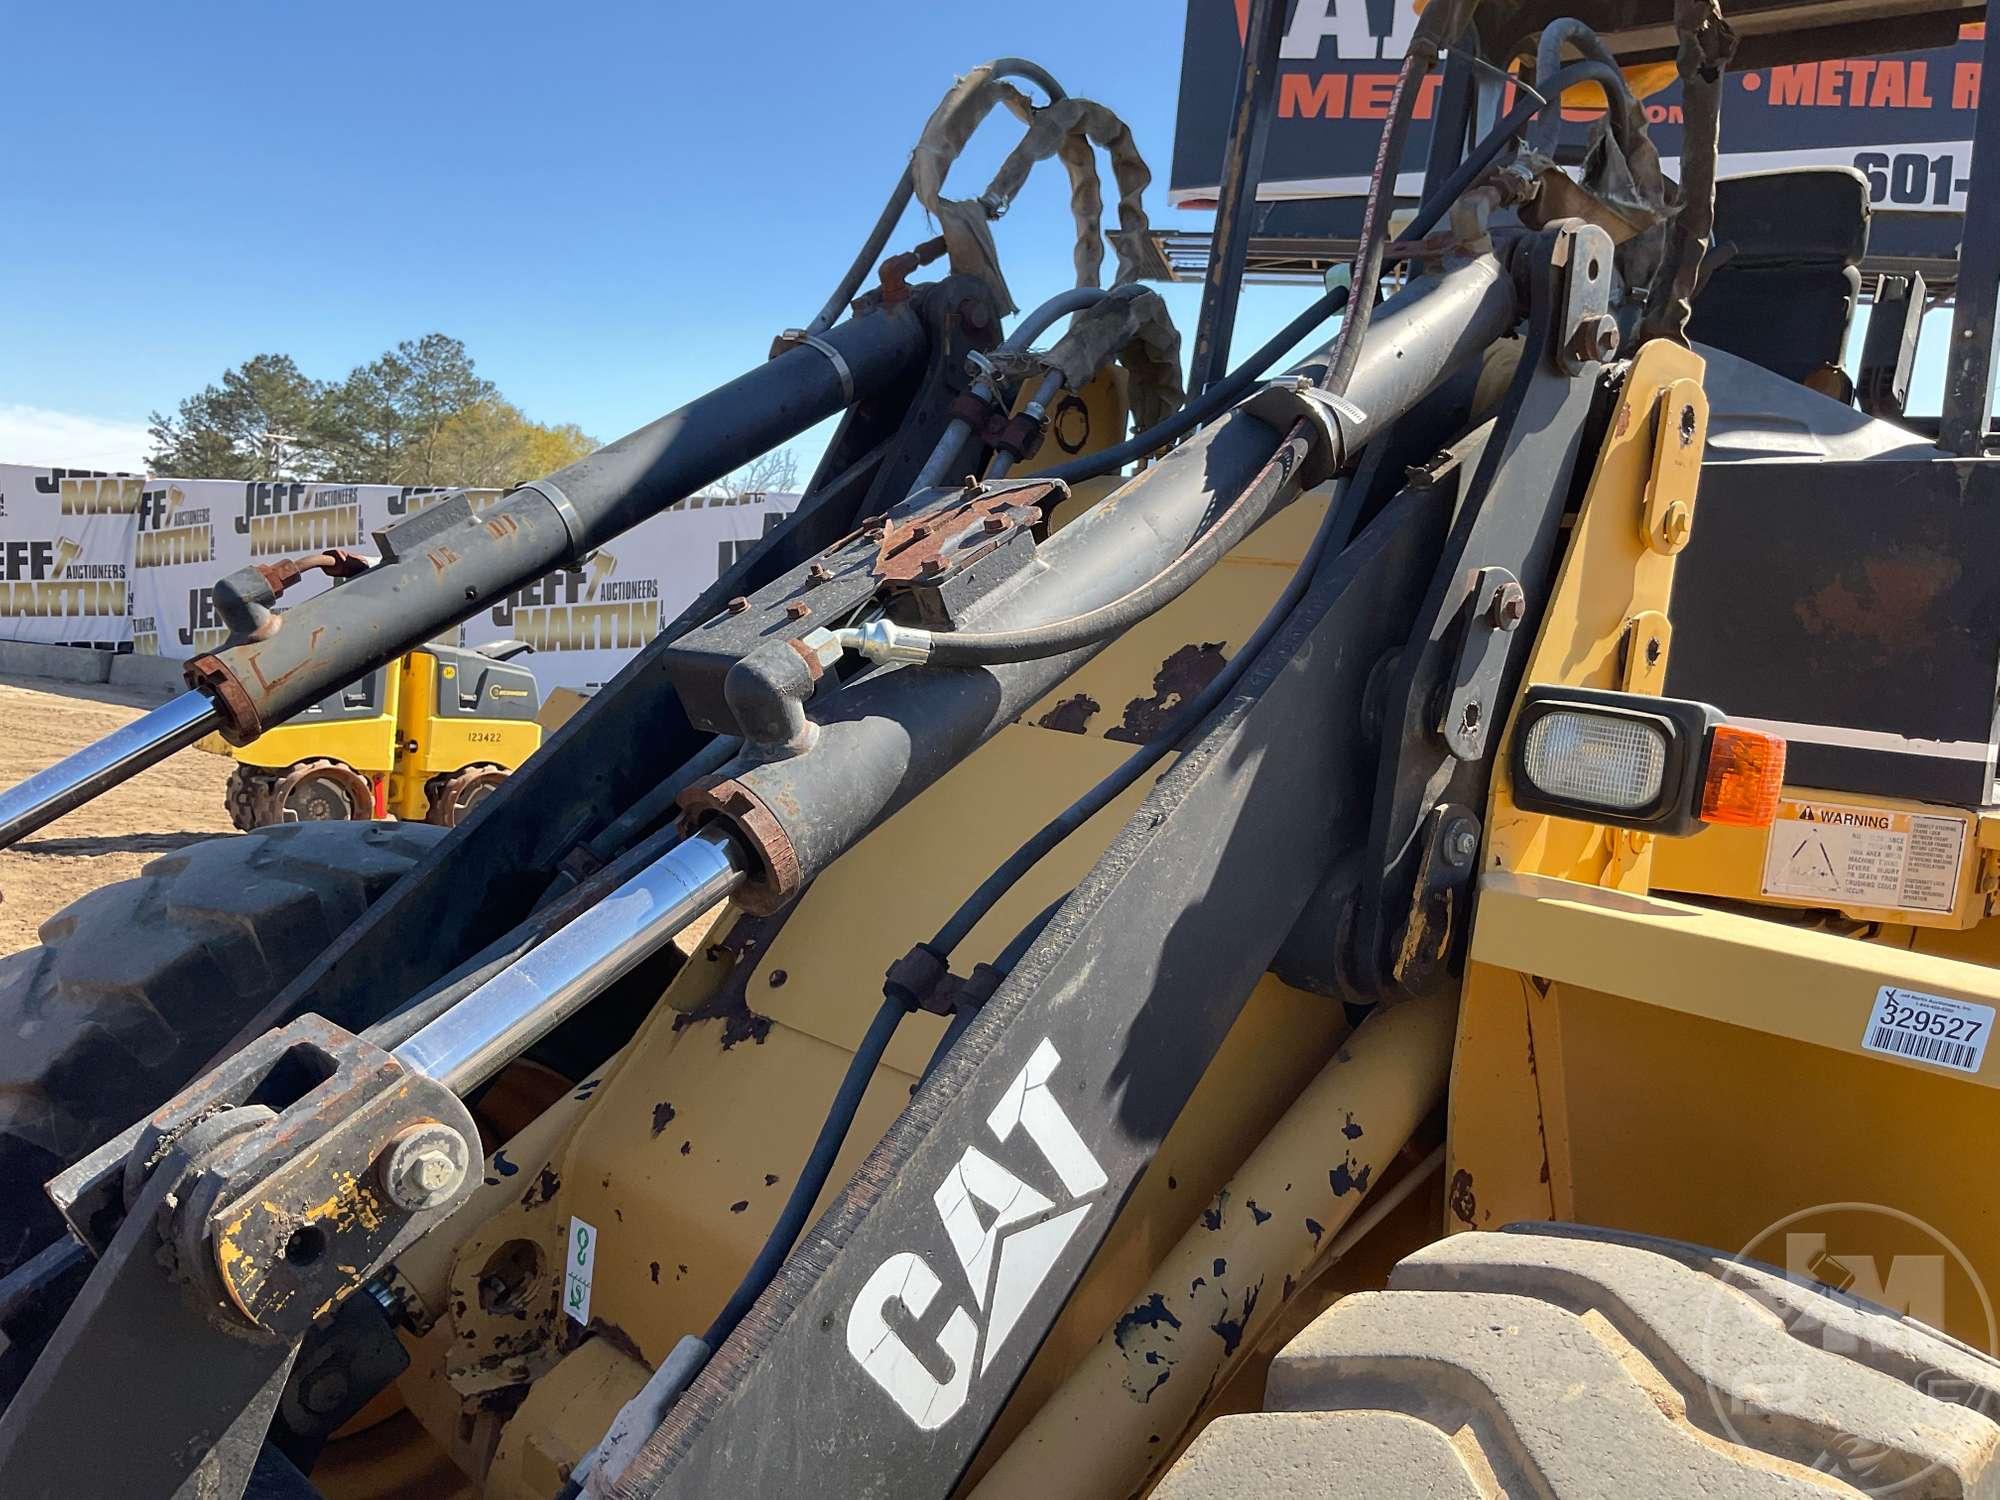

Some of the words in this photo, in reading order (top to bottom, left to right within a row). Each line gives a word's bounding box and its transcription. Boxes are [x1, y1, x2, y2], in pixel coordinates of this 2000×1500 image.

[1768, 60, 1932, 109] METAL
[1853, 152, 1968, 206] 601-
[250, 504, 358, 556] MARTIN
[66, 564, 126, 580] AUCTIONEERS
[601, 578, 659, 602] AUCTIONEERS
[514, 600, 658, 652] MARTIN
[467, 731, 503, 743] 123422
[1820, 810, 1890, 830] WARNING
[1880, 1004, 1983, 1042] 329527
[847, 1037, 1109, 1430] CAT
